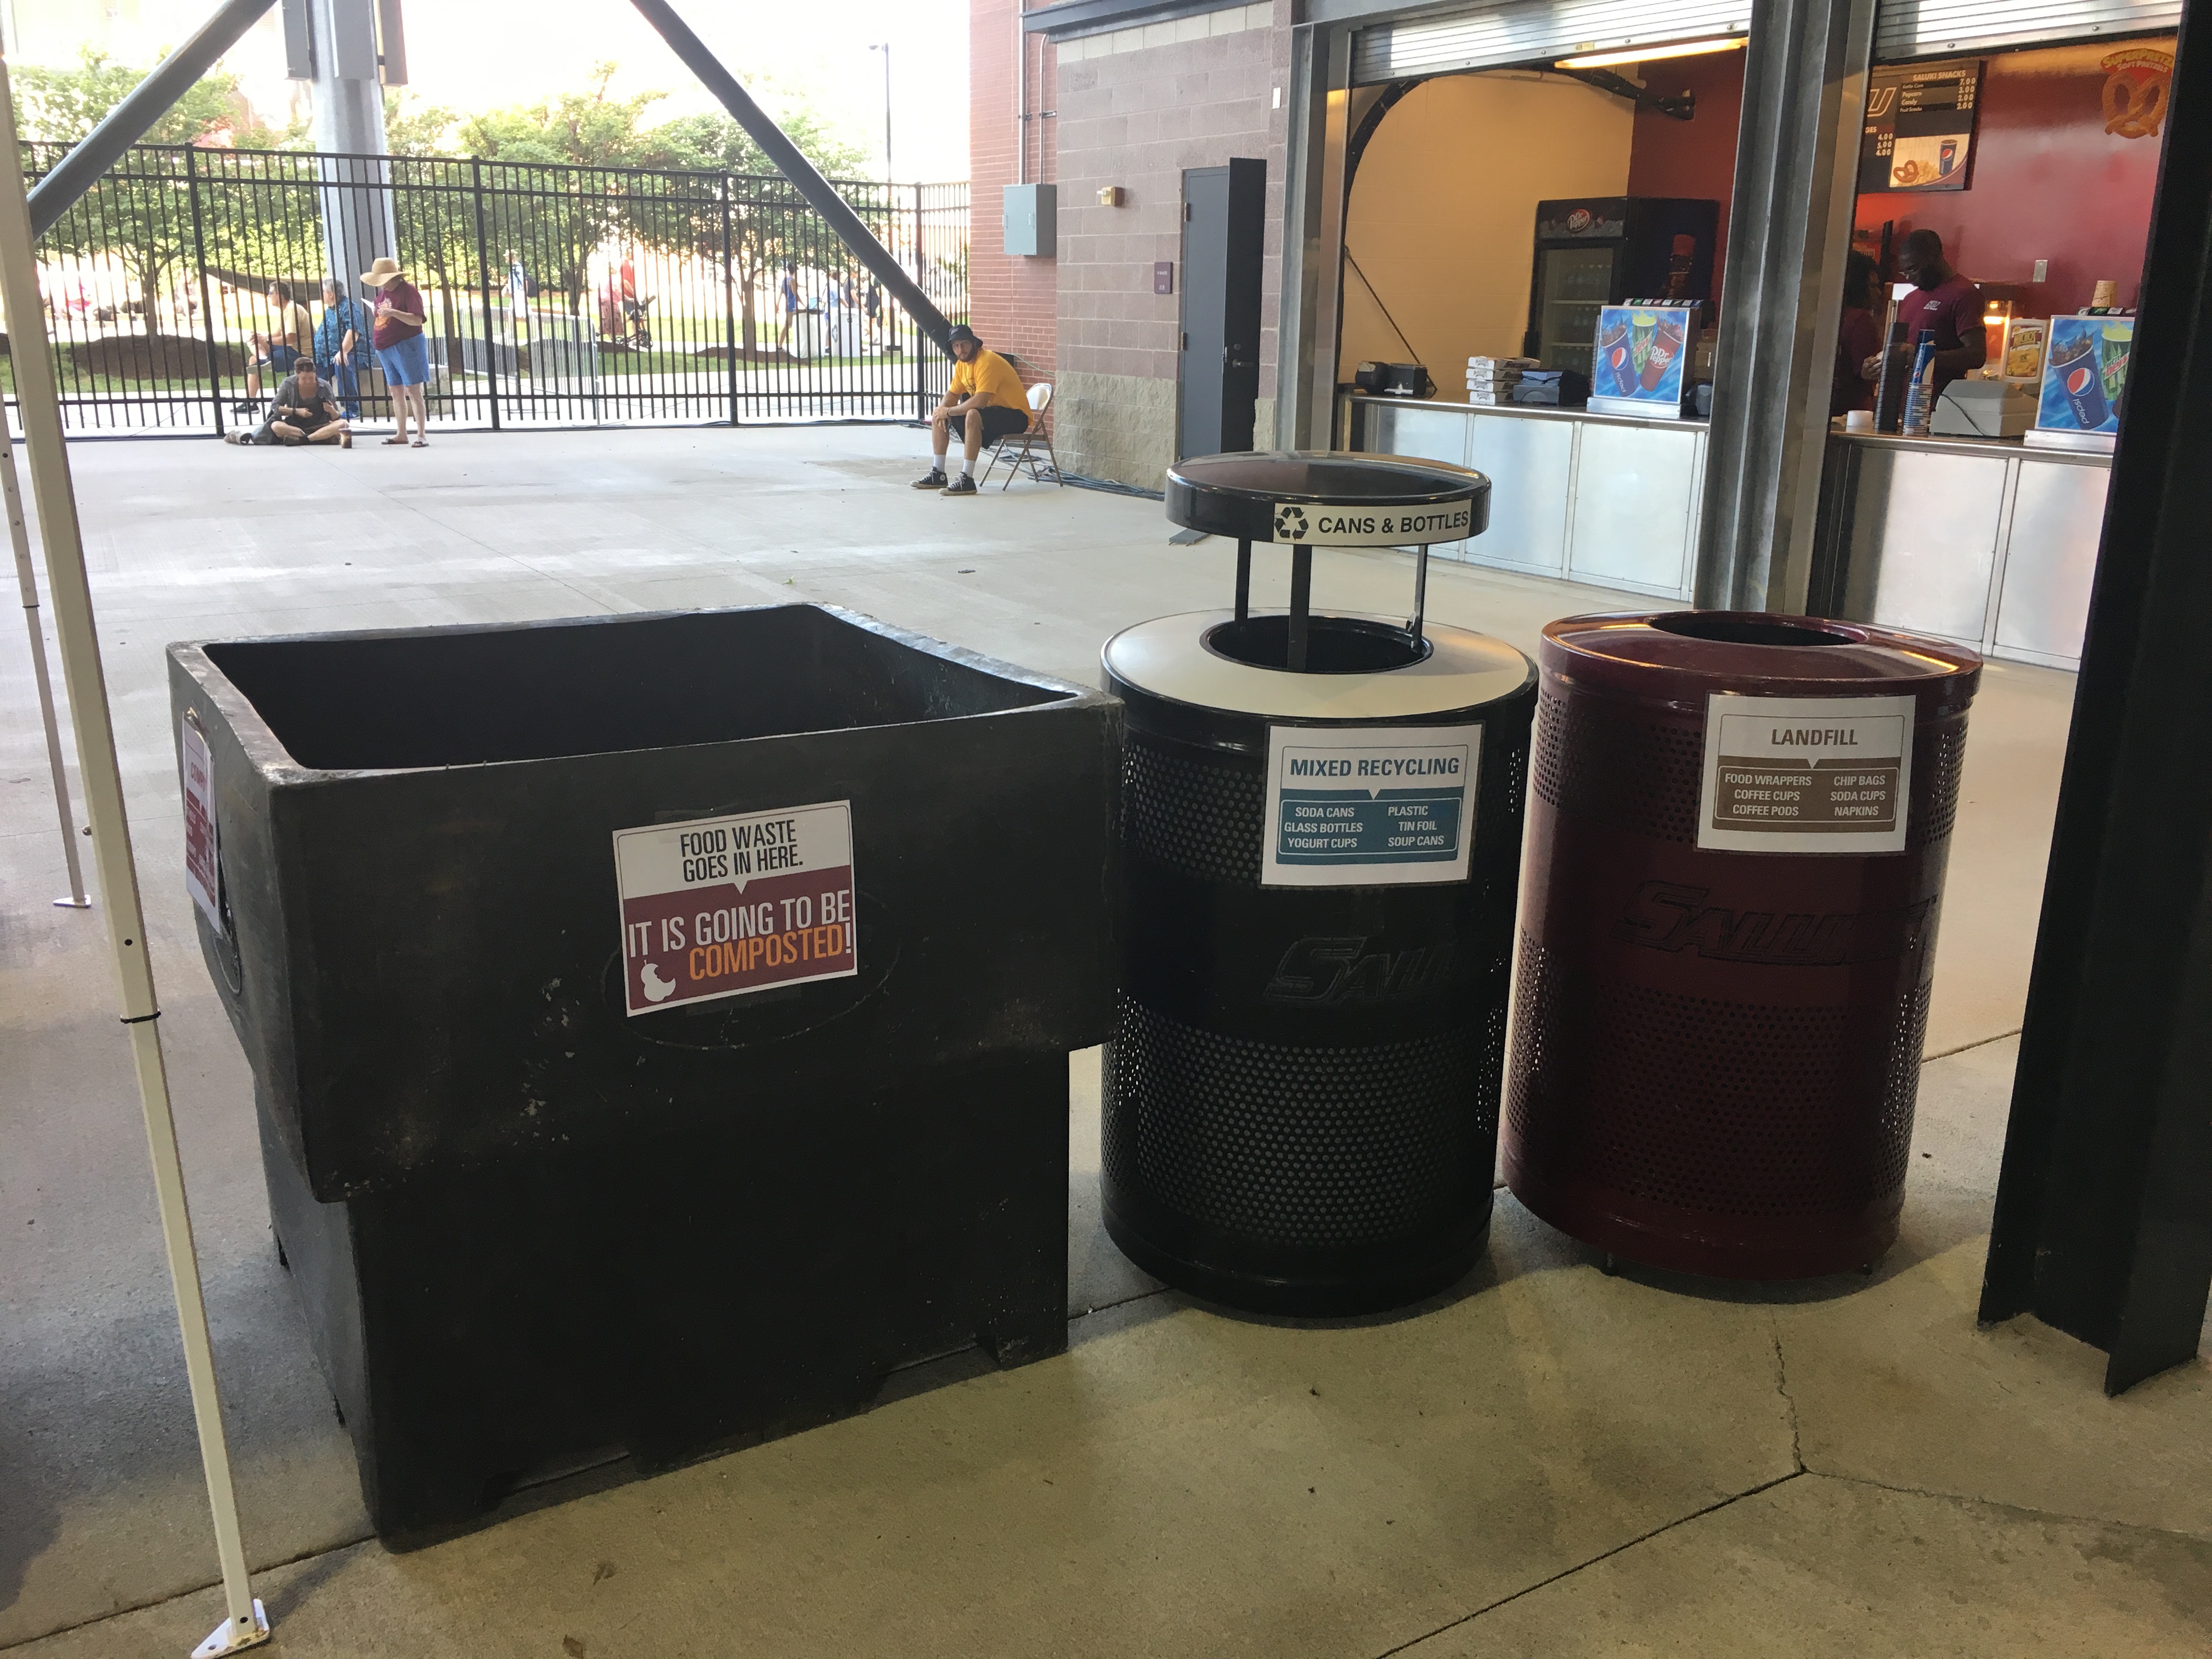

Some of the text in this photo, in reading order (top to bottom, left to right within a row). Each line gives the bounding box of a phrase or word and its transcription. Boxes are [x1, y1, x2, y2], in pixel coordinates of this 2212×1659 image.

[2117, 60, 2169, 73] SOFT PRETZELS
[1913, 70, 1966, 81] SALUKI SNACKS
[1649, 346, 1673, 365] Pepper
[1657, 348, 1669, 358] Dr
[1615, 372, 1627, 393] pepsi
[2072, 398, 2090, 425] pepsi
[1318, 511, 1469, 534] CANS & BOTTLES
[1771, 728, 1858, 746] LANDFILL
[1290, 757, 1459, 777] MIXED RECYCLING
[1724, 773, 1812, 786] FOOD WRAPPERS
[1833, 775, 1886, 786] CHIP BAGS
[1734, 789, 1800, 801] COFFEE CUPS
[1830, 791, 1886, 801] SODA CUPS
[1295, 806, 1355, 818] SODA CANS
[1388, 805, 1429, 816] PLASTIC
[1733, 804, 1799, 816] COFFEE PODS
[1834, 806, 1879, 816] NAPKINS
[1284, 821, 1363, 833] GLASS BOTTLES
[1398, 820, 1437, 832] TIN FOIL
[680, 819, 797, 857] FOOD WASTE
[1287, 837, 1357, 849] YOGURT CUPS
[1387, 835, 1444, 847] SOUP CANS
[682, 844, 804, 882] GOES IN HERE.
[628, 889, 850, 958] IT IS GOING TO BE
[689, 923, 852, 981] COMPOSTED!
